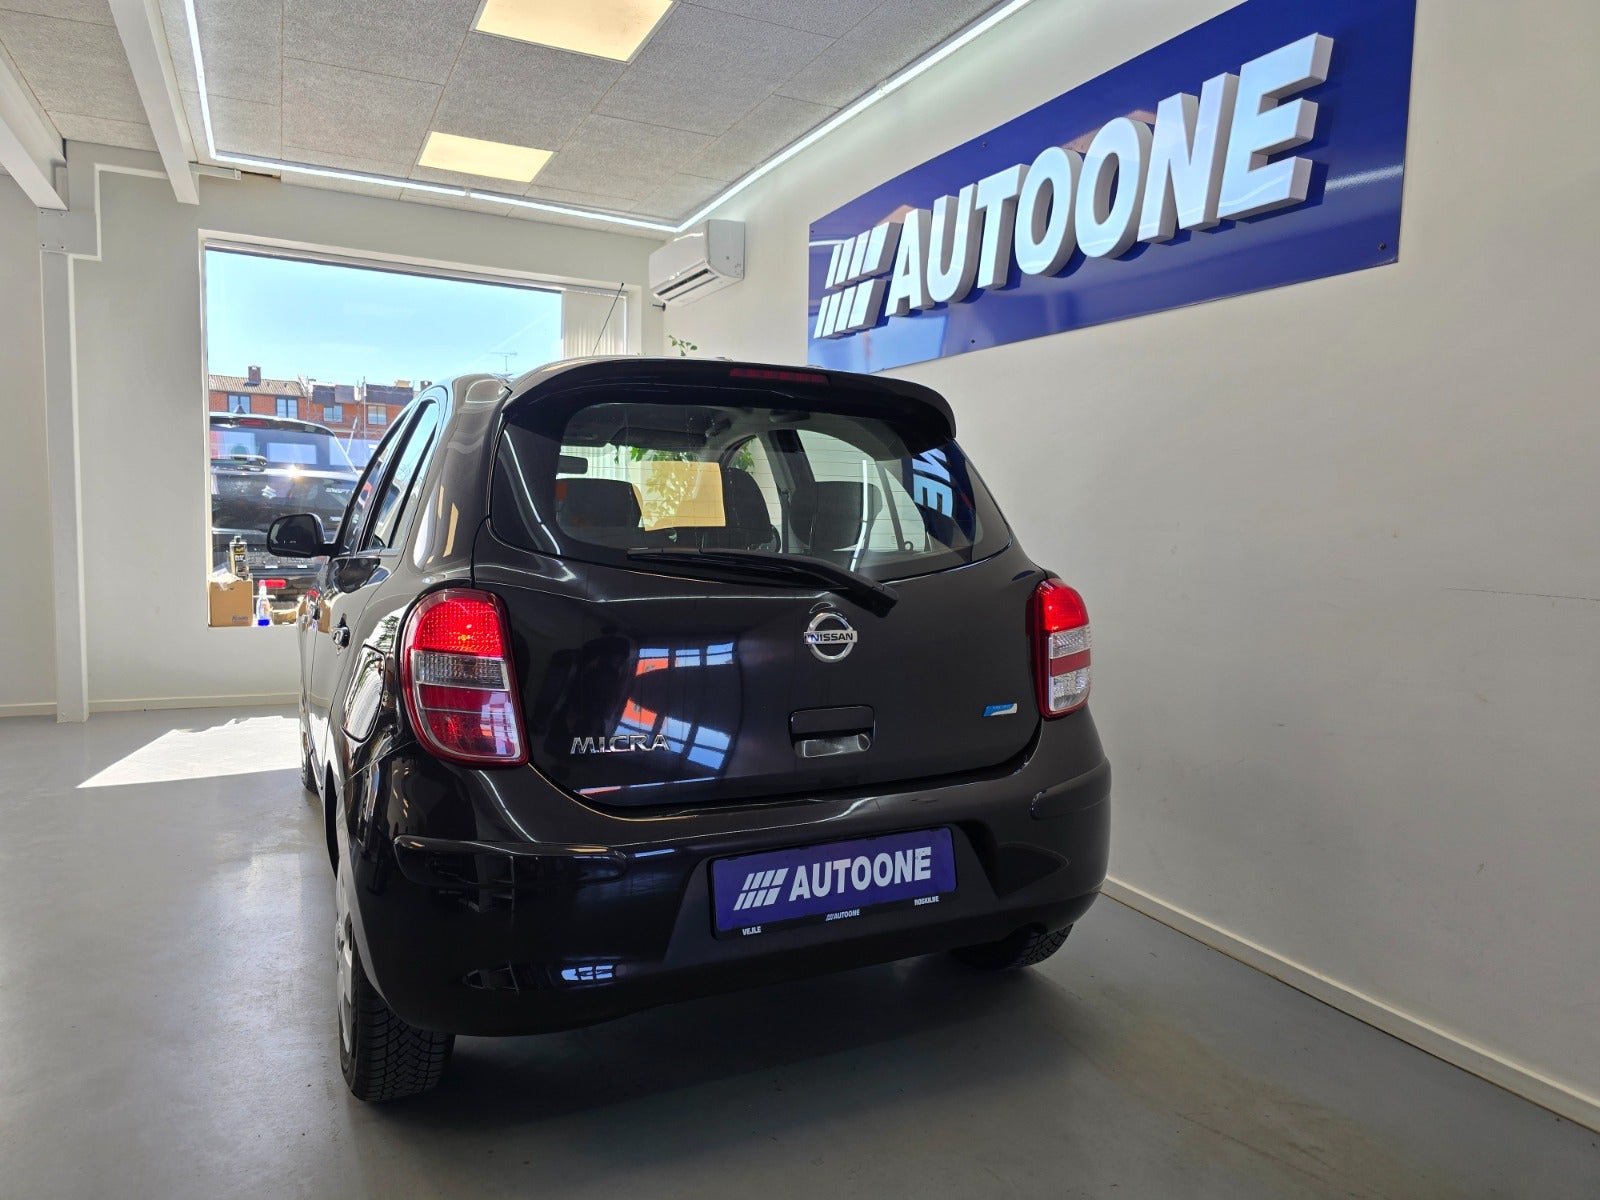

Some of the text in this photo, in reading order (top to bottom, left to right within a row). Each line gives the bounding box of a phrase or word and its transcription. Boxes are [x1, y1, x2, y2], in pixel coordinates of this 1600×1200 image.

[885, 32, 1334, 317] AUTOONE
[811, 633, 853, 642] NISSAN
[570, 734, 670, 755] MICRA
[788, 846, 932, 902] AUTOONE
[834, 908, 860, 919] AUTOONE
